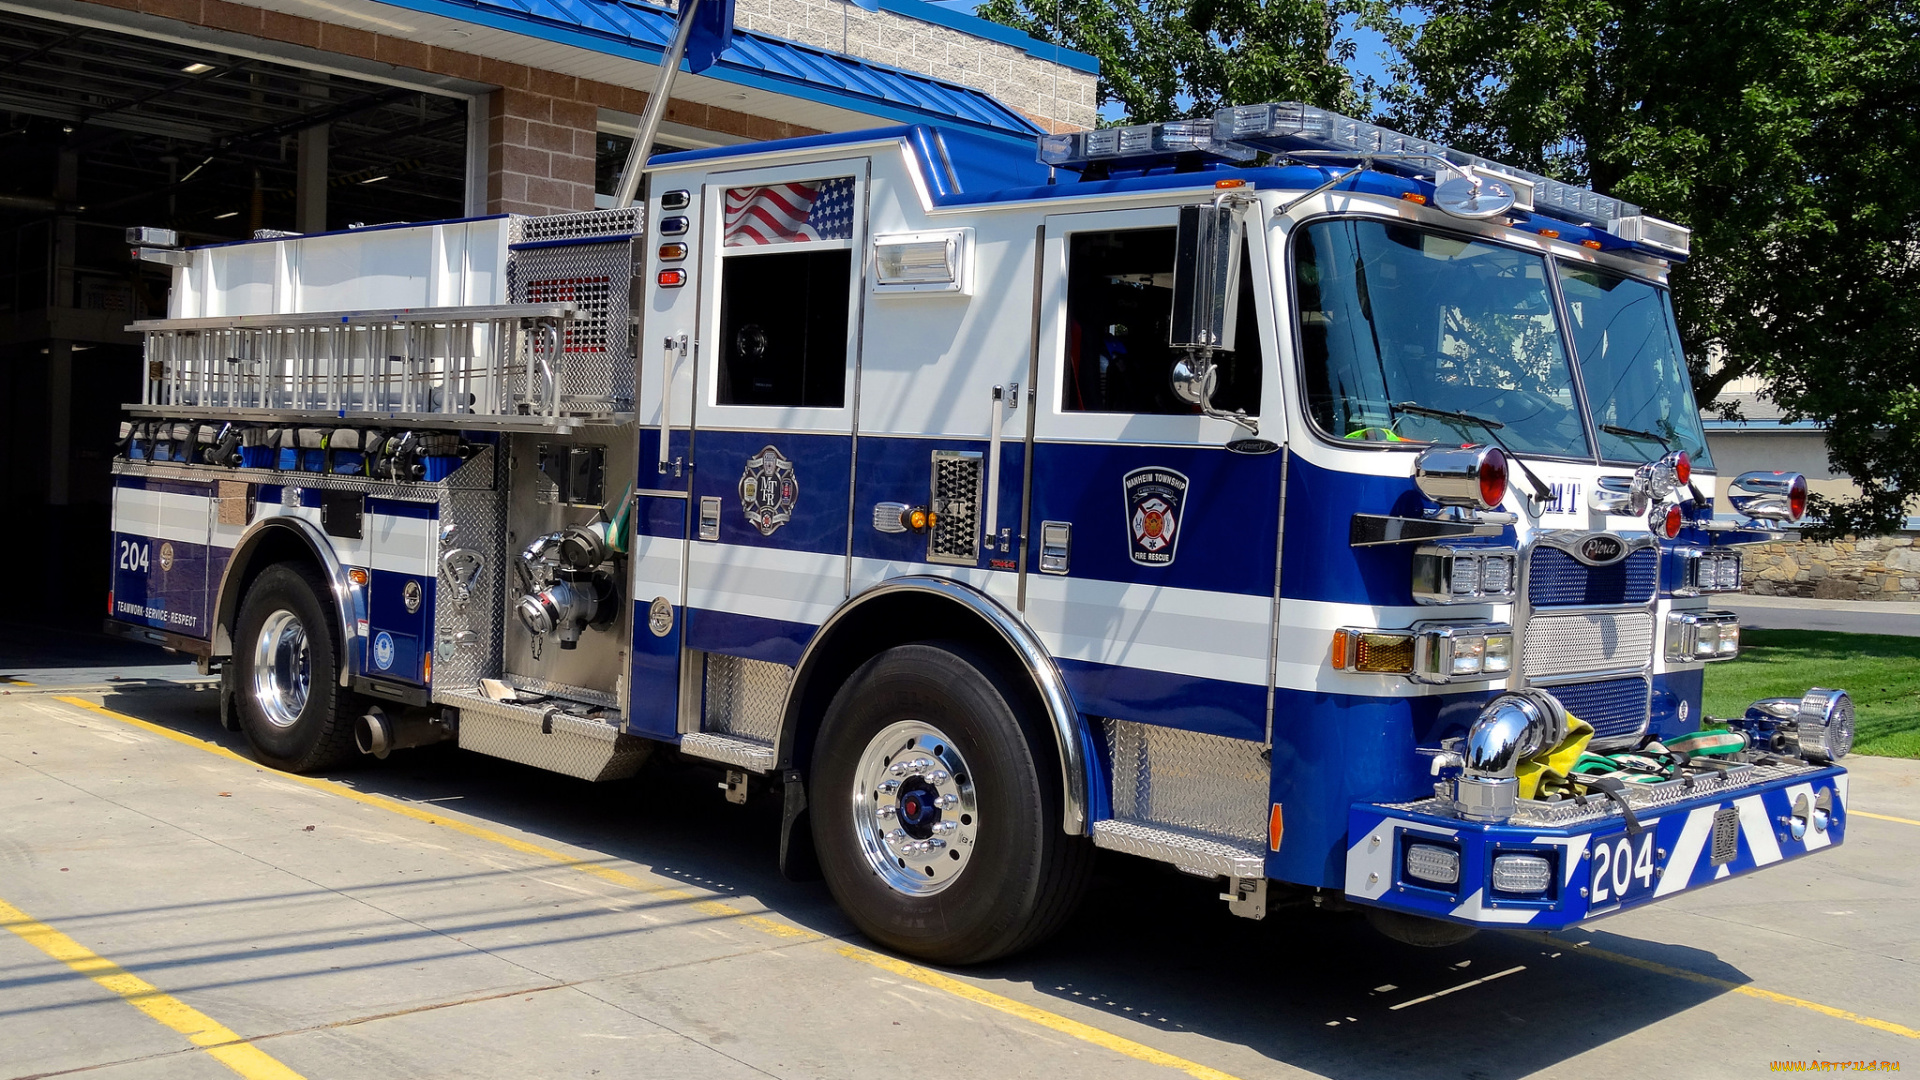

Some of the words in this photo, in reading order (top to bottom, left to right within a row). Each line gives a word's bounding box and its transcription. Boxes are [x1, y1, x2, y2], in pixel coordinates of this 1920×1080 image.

[1126, 474, 1153, 489] MANHEIM
[1155, 473, 1186, 490] TOWNSHIP
[1586, 539, 1616, 556] Pierce
[120, 540, 149, 573] 204
[1135, 552, 1147, 560] FIRE
[1148, 553, 1169, 561] RESCUE
[1592, 832, 1654, 904] 204
